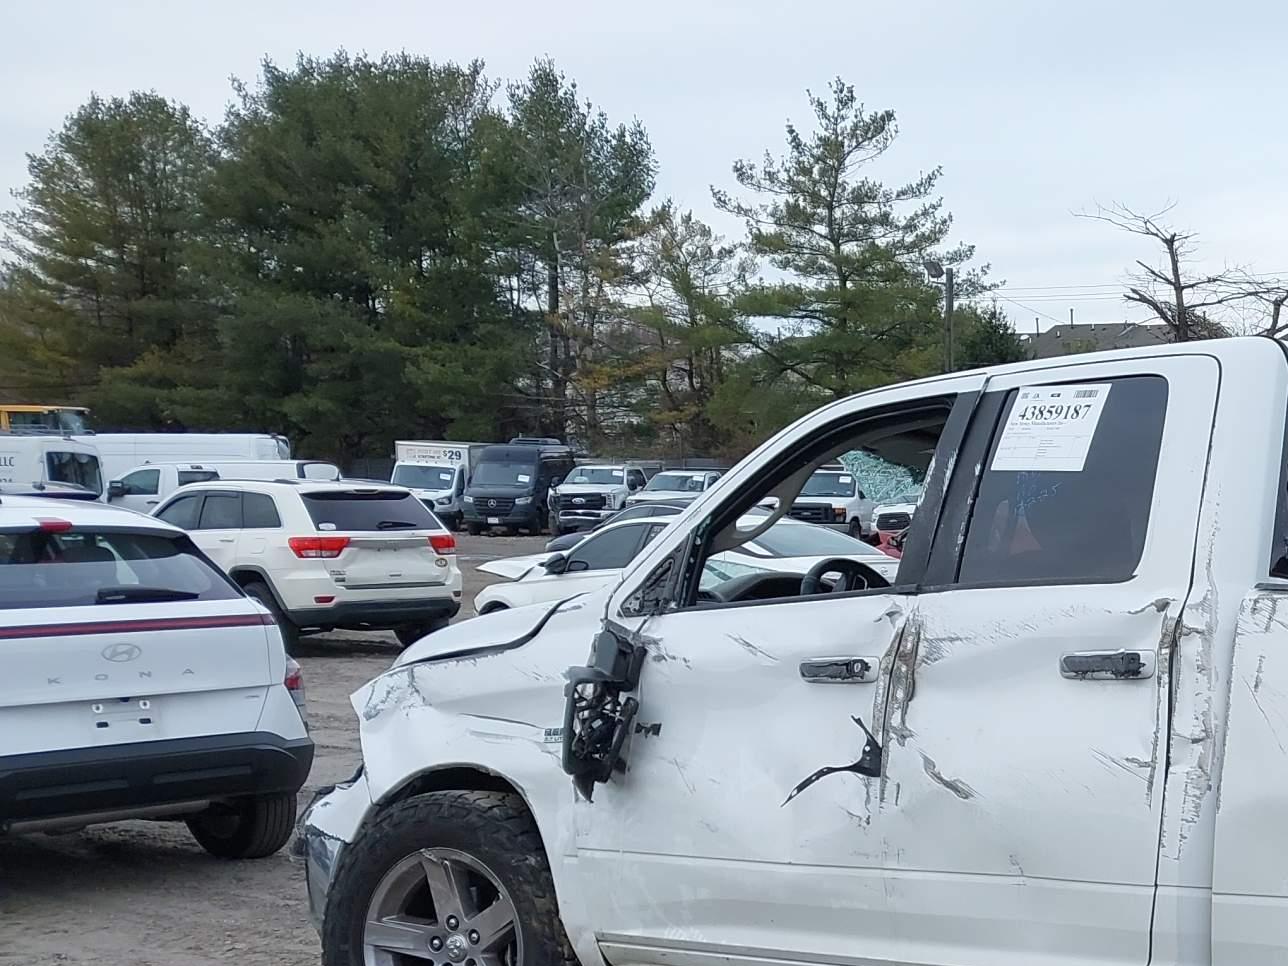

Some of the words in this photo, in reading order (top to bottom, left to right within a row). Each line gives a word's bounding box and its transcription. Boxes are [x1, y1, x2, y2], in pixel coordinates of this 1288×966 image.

[1018, 404, 1092, 420] 43859187
[442, 449, 462, 461] $29
[47, 668, 195, 685] KONA
